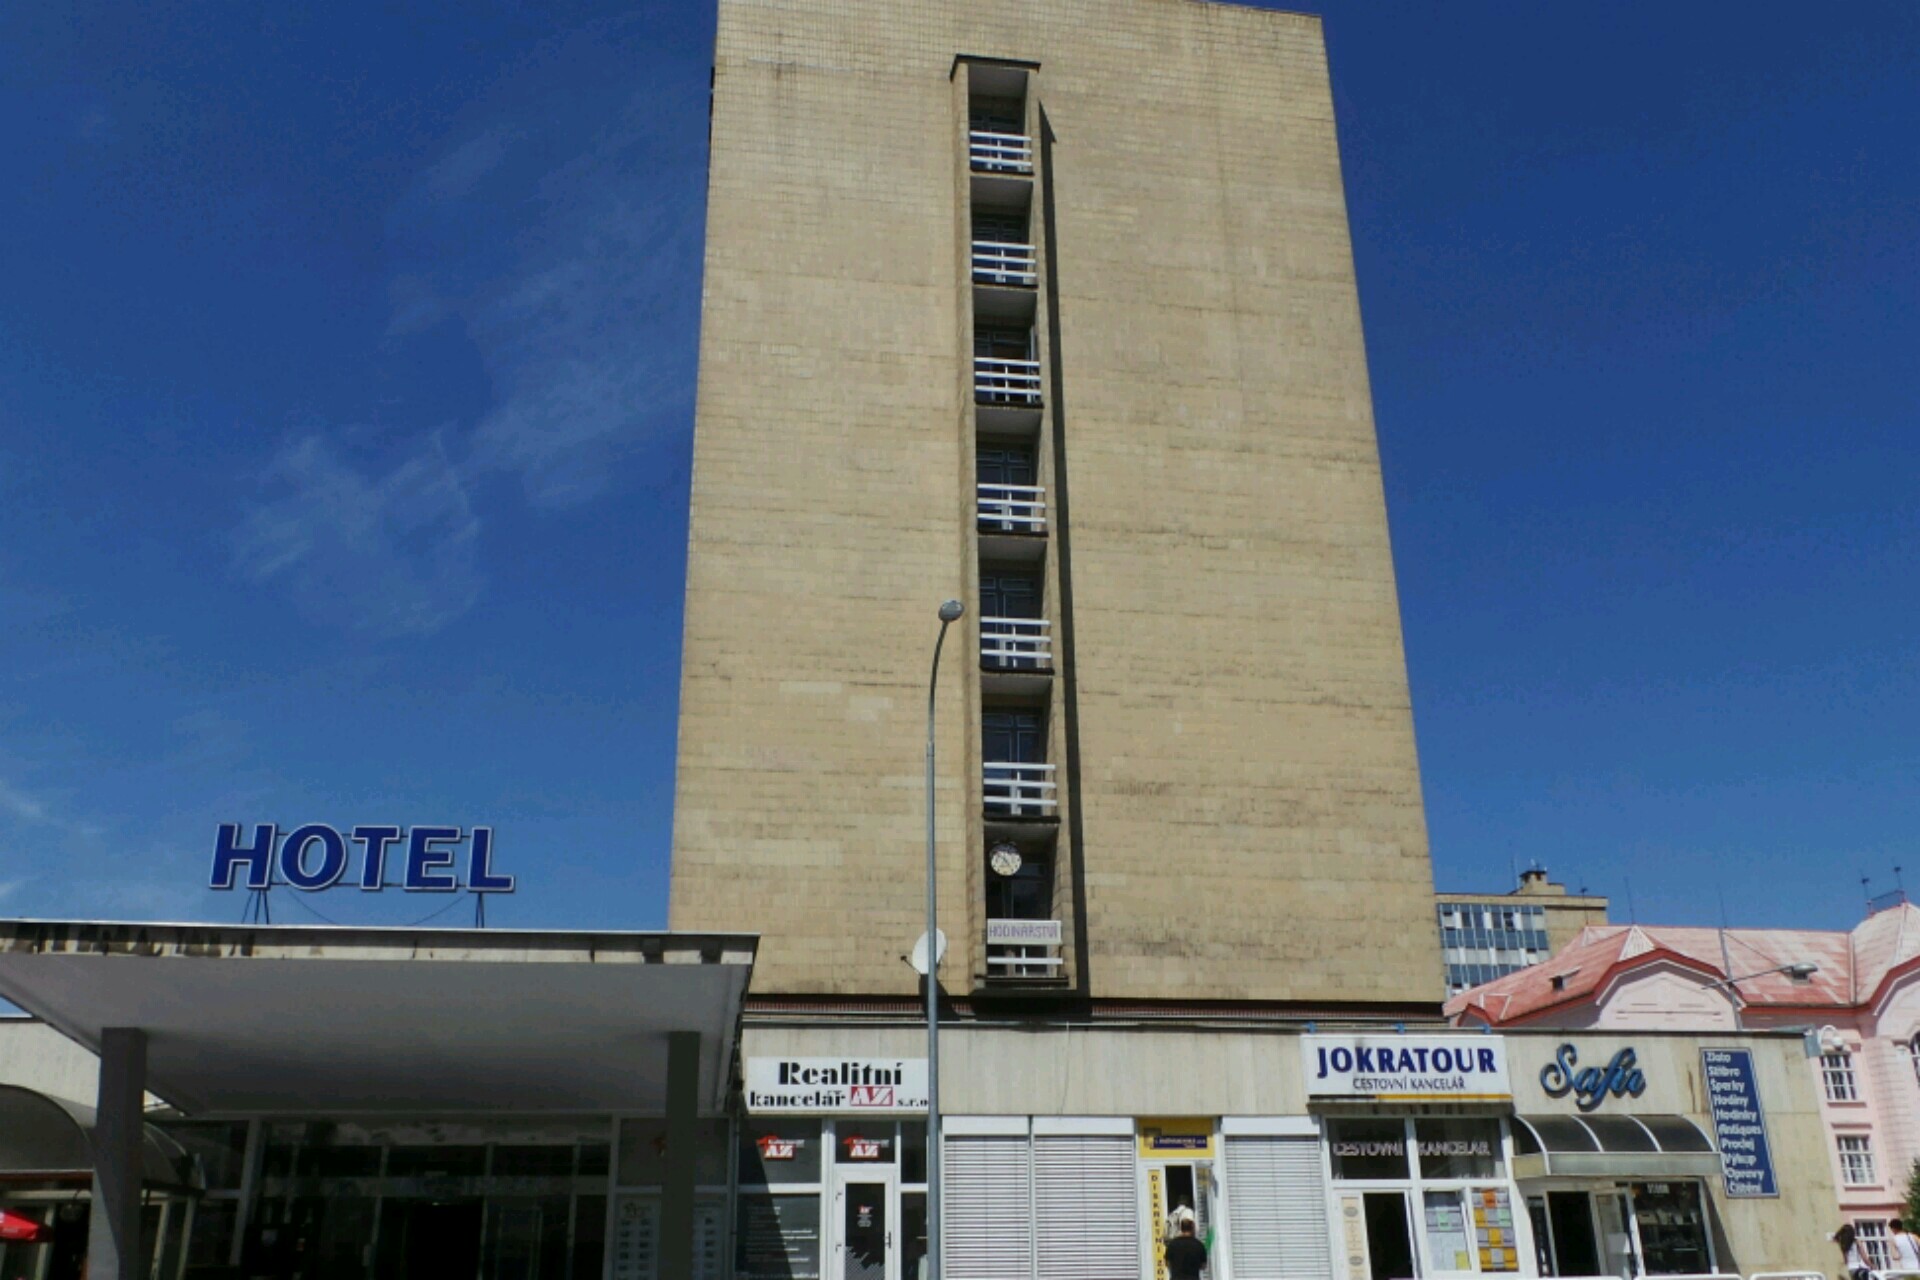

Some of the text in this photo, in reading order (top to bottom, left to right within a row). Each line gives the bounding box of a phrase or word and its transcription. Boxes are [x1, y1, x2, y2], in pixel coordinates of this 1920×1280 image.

[209, 823, 515, 892] HOTEL
[1317, 1046, 1497, 1079] JOKRATOUR
[1706, 1052, 1731, 1062] Zlato
[779, 1062, 903, 1085] Realitní
[1352, 1076, 1465, 1091] CESTOVNÍ KANCELÁŘ
[1710, 1079, 1745, 1093] Šperky
[750, 1091, 846, 1107] kancelář
[851, 1087, 893, 1106] AZ
[1713, 1094, 1749, 1108] Hodiny
[1716, 1109, 1757, 1122] Hodinky
[1721, 1138, 1755, 1152] Prodej
[1722, 1153, 1757, 1166] Výkup
[1727, 1168, 1765, 1181] Opravy
